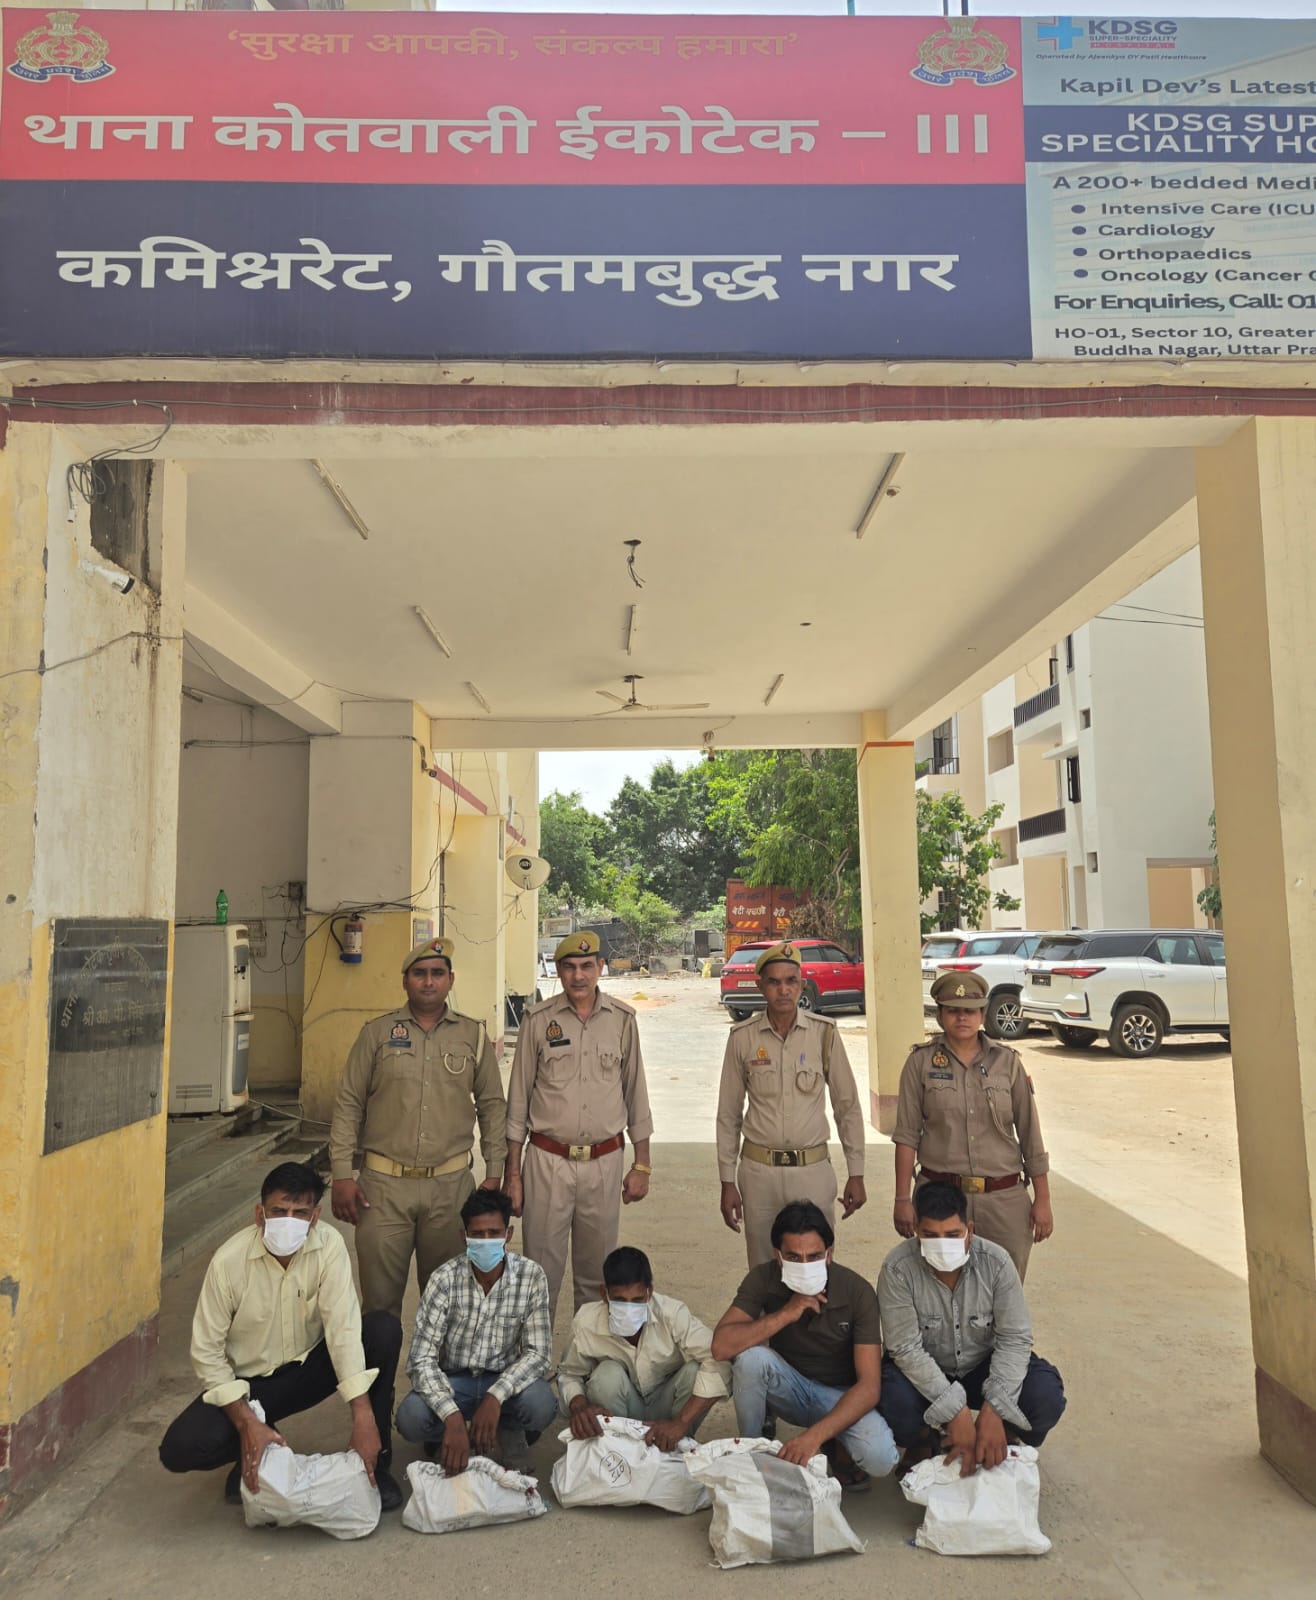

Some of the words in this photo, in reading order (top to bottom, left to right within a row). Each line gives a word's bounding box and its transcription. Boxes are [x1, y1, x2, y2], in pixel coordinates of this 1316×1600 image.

[1089, 20, 1178, 35] KDSG
[366, 28, 519, 61] आपकी,
[533, 29, 664, 57] संकल्प
[1060, 78, 1134, 96] Kapil
[1142, 79, 1222, 94] Dev’s
[1230, 79, 1316, 94] Latest
[1127, 112, 1232, 132] KDSG
[1244, 113, 1316, 133] SUP
[23, 114, 193, 151] थाना
[212, 103, 537, 155] कोतवाली
[556, 105, 819, 160] ईकोटेक
[1041, 134, 1265, 153] SPECIALITY
[1053, 176, 1071, 189] A
[1078, 176, 1143, 190] 200+
[1151, 176, 1248, 190] bedded
[1101, 203, 1205, 215] Intensive
[1210, 203, 1262, 215] Care
[1268, 203, 1316, 216] (ICU
[1098, 224, 1216, 239] Cardiology
[1098, 248, 1252, 262] Orthopaedics
[55, 235, 412, 302] कमिश्नरेट,
[438, 240, 781, 307] गौतमबुद्ध
[802, 254, 959, 292] नगर
[1101, 269, 1209, 284] Oncology
[1215, 269, 1303, 283] (Cancer
[1054, 294, 1097, 310] For
[1101, 293, 1226, 312] Enquiries,
[1229, 293, 1283, 309] Call:
[1055, 328, 1127, 341] HO-01,
[1131, 328, 1199, 338] Sector
[1203, 328, 1233, 340] 10,
[1238, 327, 1316, 338] Greater
[1074, 345, 1153, 356] Buddha
[1158, 345, 1222, 357] Nagar,
[1228, 344, 1281, 356] Uttar
